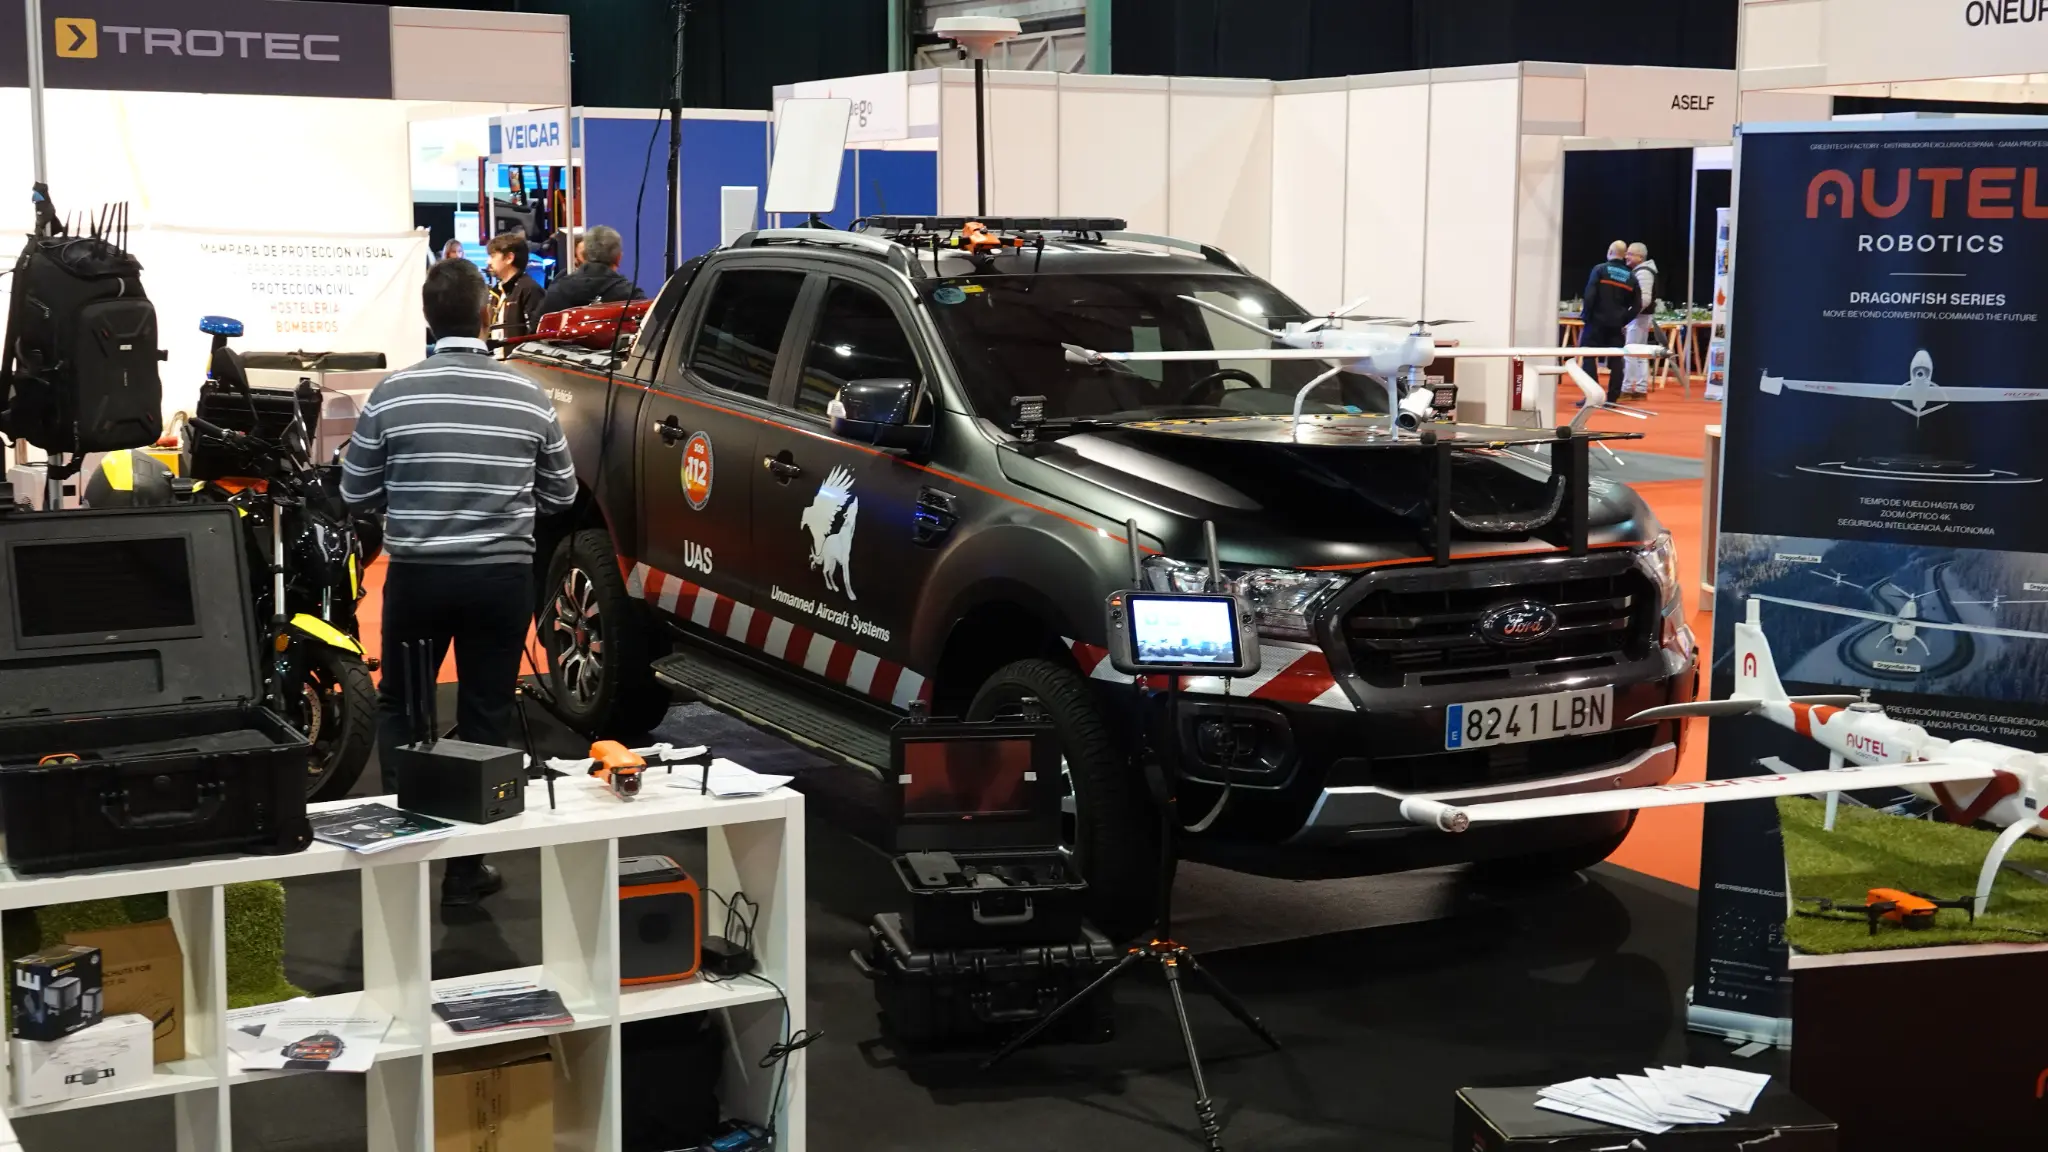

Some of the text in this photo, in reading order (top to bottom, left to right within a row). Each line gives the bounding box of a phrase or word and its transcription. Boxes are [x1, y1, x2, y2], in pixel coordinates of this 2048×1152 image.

[103, 25, 340, 62] TROTEC
[1671, 94, 1715, 111] ASELF
[505, 121, 560, 150] VEICAR
[1806, 167, 2048, 219] AUTEL
[201, 243, 394, 258] MAMPARA DE PROTECCION VISUAL
[1858, 234, 2004, 253] ROBOTICS
[251, 282, 354, 295] PROTECCION CIVIL
[1850, 291, 2006, 306] DRAGONFISH SERIES
[1823, 309, 1847, 318] MOVE
[1848, 310, 1881, 318] BEYOND
[1938, 312, 1985, 321] COMMAND
[1986, 313, 2002, 321] THE
[2003, 313, 2038, 322] FUTURE
[276, 320, 338, 333] BOMBEROS
[687, 456, 708, 486] 112
[1859, 497, 1890, 506] TIEMPO
[1890, 498, 1901, 507] DE
[1903, 499, 1930, 509] VUELO
[1931, 501, 1958, 510] HASTA
[1880, 509, 1906, 518] ZOOM
[684, 539, 713, 574] UAS
[770, 584, 891, 642] Unmanned Aircraft Systems
[1503, 613, 1544, 635] Ford
[1466, 693, 1605, 742] 8241 LBN
[1451, 731, 1458, 741] E
[1950, 722, 1990, 733] POLICIAL
[1846, 732, 1888, 758] AUTEL
[1759, 889, 1788, 898] EXCLUS
